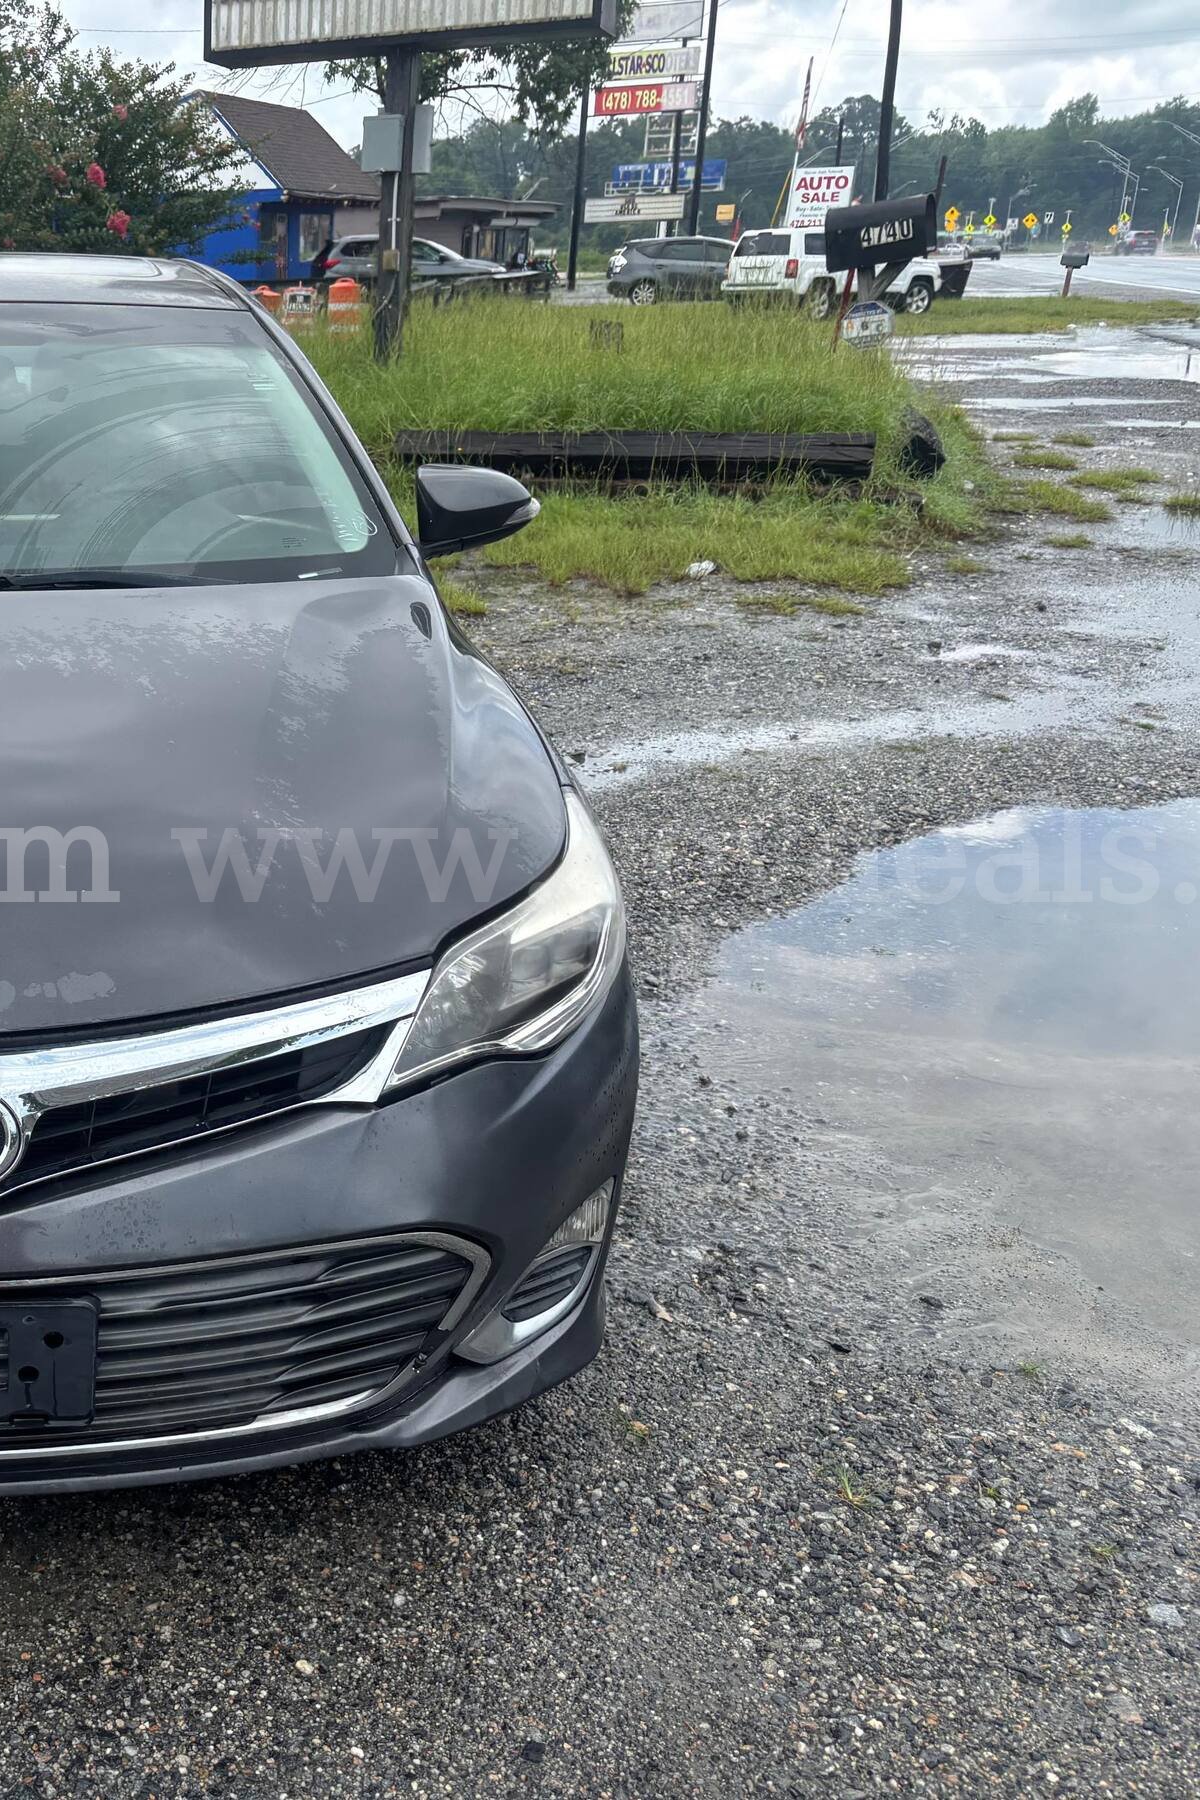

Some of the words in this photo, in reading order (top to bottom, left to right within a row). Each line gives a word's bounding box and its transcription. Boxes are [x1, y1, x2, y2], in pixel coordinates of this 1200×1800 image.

[602, 90, 632, 111] (478)
[795, 175, 849, 191] AUTO
[801, 192, 840, 203] SALE
